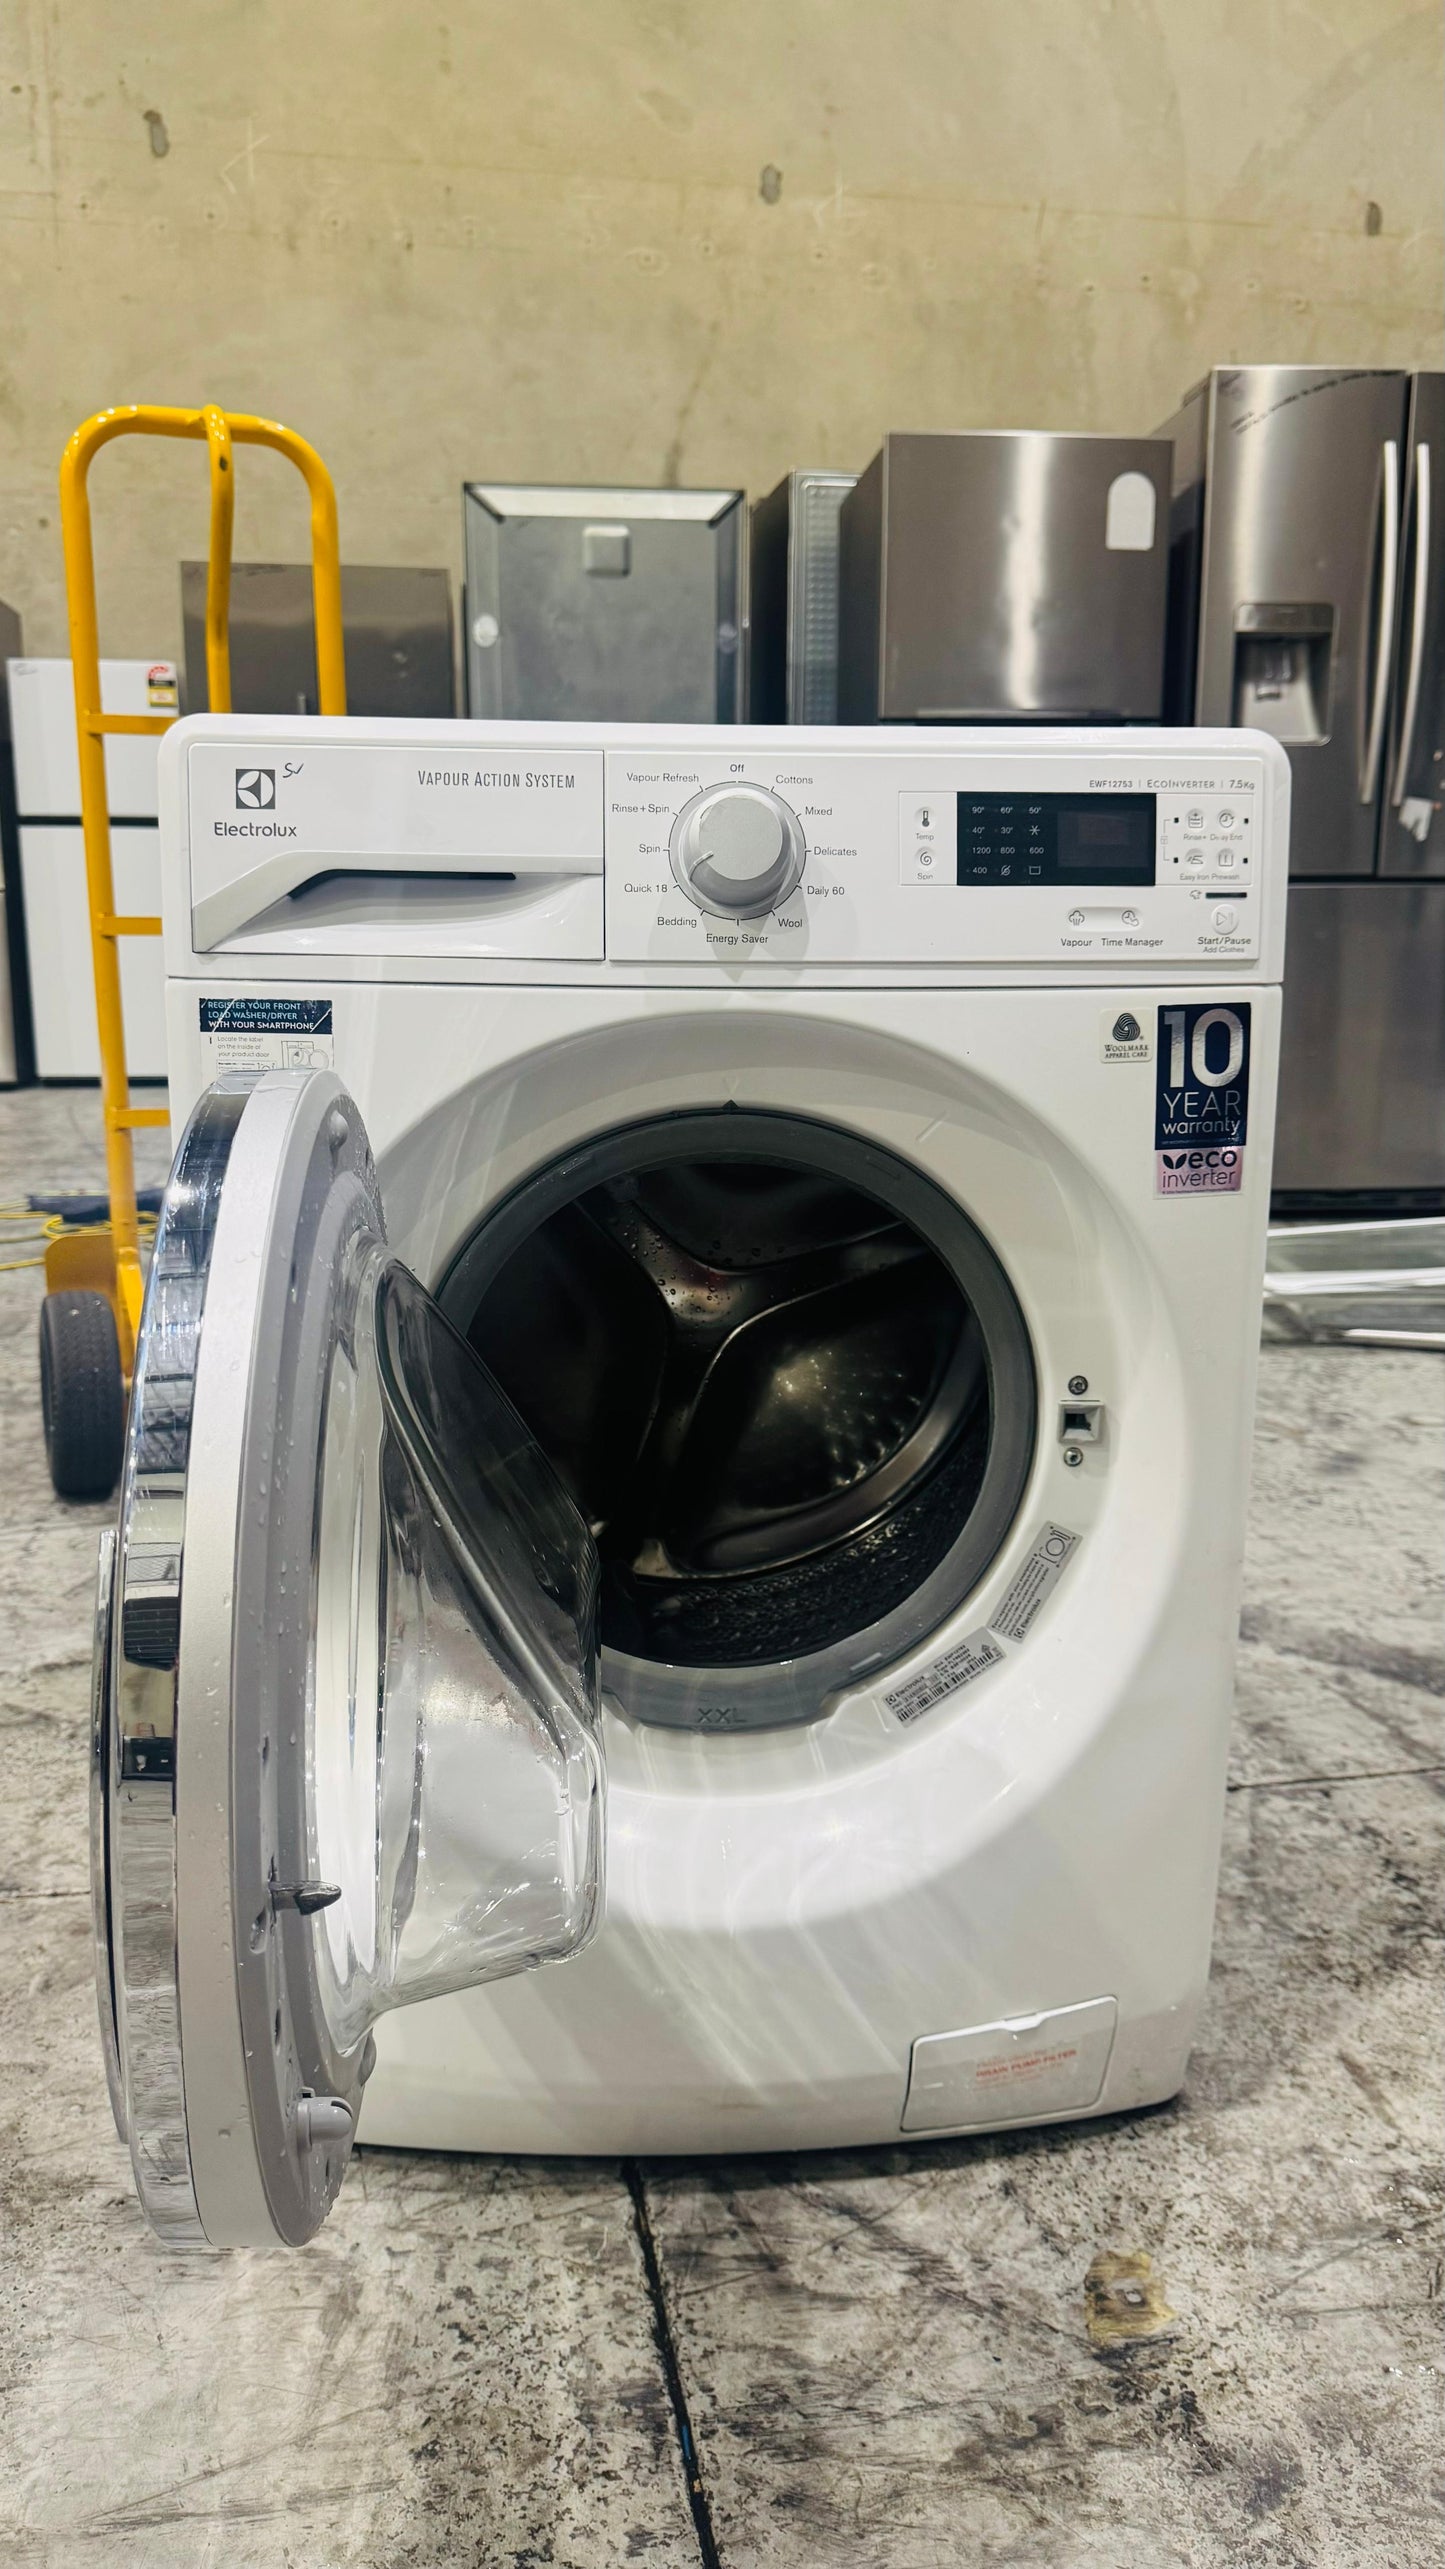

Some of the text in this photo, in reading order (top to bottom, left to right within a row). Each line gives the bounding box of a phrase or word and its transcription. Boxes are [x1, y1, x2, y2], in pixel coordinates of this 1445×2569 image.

[729, 764, 745, 773] Off
[418, 770, 575, 789] VAPOUR ACTION SYSTEM
[626, 772, 700, 783] Vapour Refresh
[775, 774, 814, 784] Cottons
[1089, 779, 1133, 788] EWF12753
[805, 806, 833, 816] Mixed
[214, 822, 297, 837] Electrolux
[916, 832, 935, 841] Temp
[639, 844, 661, 854] Spin
[814, 846, 857, 856] Delicates
[972, 847, 1045, 855] 1200 800 600
[917, 872, 934, 881] Spin
[1180, 873, 1196, 882] Easy
[624, 883, 668, 893] Quick 18
[807, 886, 845, 897] Daily 60
[657, 917, 697, 928] Bedding
[778, 918, 803, 928] Wool
[706, 933, 769, 945] Energy Saver
[1061, 938, 1092, 947] Vapour
[1101, 938, 1163, 948] Time Manager
[1198, 936, 1251, 945] Start/Pause
[208, 1002, 246, 1010] REGISTER
[248, 1002, 271, 1010] YOUR
[208, 1011, 298, 1020] LOAD WASHER/DRYER
[208, 1020, 315, 1030] WITH YOUR SMARTPHONE
[1104, 1044, 1149, 1052] WOOLMARK
[1164, 1008, 1244, 1088] 10
[1163, 1090, 1241, 1120] YEAR
[1163, 1117, 1241, 1136] warranty
[1188, 1150, 1237, 1169] eco
[1163, 1169, 1236, 1188] inverter
[1020, 1598, 1042, 1629] Electrolux
[894, 1675, 926, 1699] Electrolux
[698, 1708, 747, 1724] XXL
